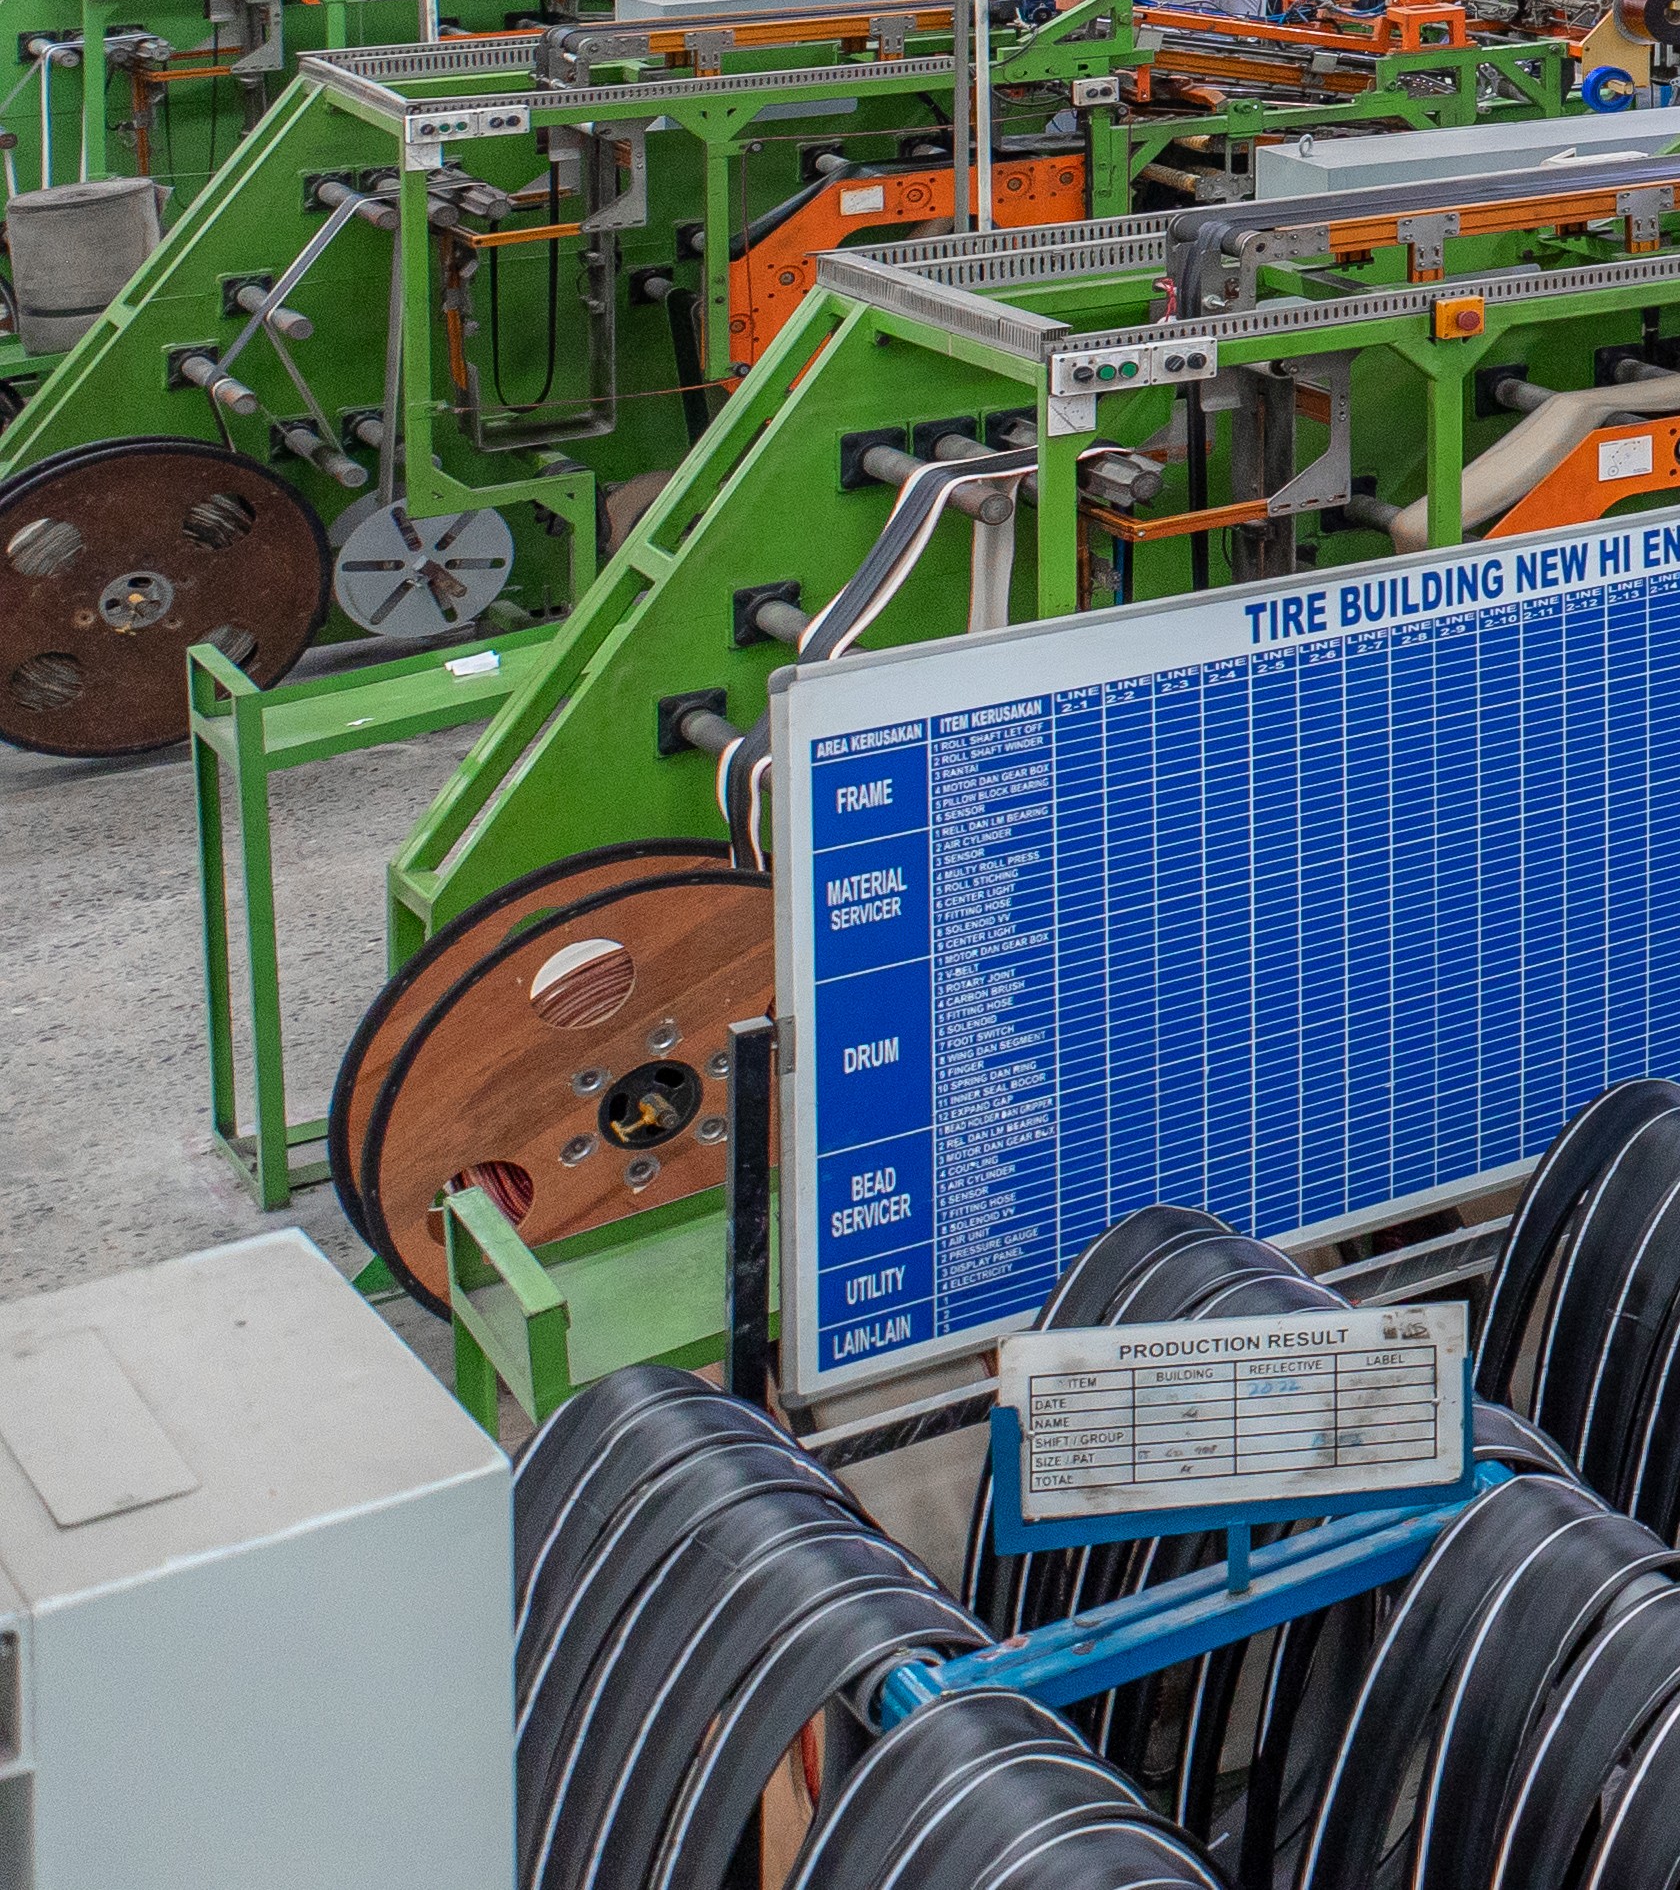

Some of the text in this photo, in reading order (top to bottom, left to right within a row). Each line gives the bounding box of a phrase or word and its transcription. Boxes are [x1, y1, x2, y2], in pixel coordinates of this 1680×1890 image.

[1244, 590, 1327, 644] TIRE
[1341, 564, 1504, 627] BUILDING
[1515, 541, 1589, 593] NEW
[1600, 534, 1631, 577] HI
[1608, 578, 1643, 593] LINE
[1523, 594, 1560, 610] LINE
[1608, 589, 1639, 603] 2-13
[1435, 611, 1476, 629] LINE
[1523, 606, 1555, 621] 2-11
[1346, 628, 1387, 647] LINE
[1439, 622, 1466, 636] 2-9
[1357, 640, 1383, 654] 2-7
[1105, 675, 1151, 692] LINE
[1056, 686, 1099, 702] LINE
[1106, 690, 1135, 704] 2-2
[1061, 700, 1088, 713] 2-1
[940, 699, 1042, 734] ITEM KERUSAKAN
[816, 723, 922, 758] AREA KERUSAKAN
[941, 735, 966, 752] ROLL
[970, 729, 1002, 746] SHAFT
[1003, 725, 1021, 739] LET
[1024, 722, 1043, 735] OFF
[941, 750, 966, 766] ROLL
[970, 743, 1002, 760] SHAFT
[1005, 736, 1043, 753] WINDER
[836, 778, 893, 814] FRAME
[827, 866, 907, 907] MATERIAL
[831, 896, 902, 931] SERVICER
[843, 1037, 899, 1074] DRUM
[851, 1166, 896, 1201] BEAD
[831, 1193, 911, 1238] SERVICER
[948, 1233, 965, 1248] AIR
[968, 1227, 990, 1242] UNIT
[846, 1265, 906, 1305] UTILITY
[833, 1313, 911, 1360] LAIN-LAIN
[1119, 1328, 1350, 1361] PRODUCTION RESULT
[1249, 1359, 1323, 1375] REFLECTIVE
[1366, 1353, 1404, 1367] LABEL
[1068, 1377, 1097, 1389] ITEM
[1156, 1367, 1214, 1383] BUILDING
[1034, 1397, 1066, 1411] DATE
[1034, 1417, 1070, 1429] NAME
[1034, 1434, 1071, 1449] SHIFT
[1080, 1430, 1125, 1447] GROUP
[1034, 1455, 1060, 1468] SIZE
[1071, 1452, 1096, 1465] PAT
[1034, 1473, 1074, 1486] TOTAL
